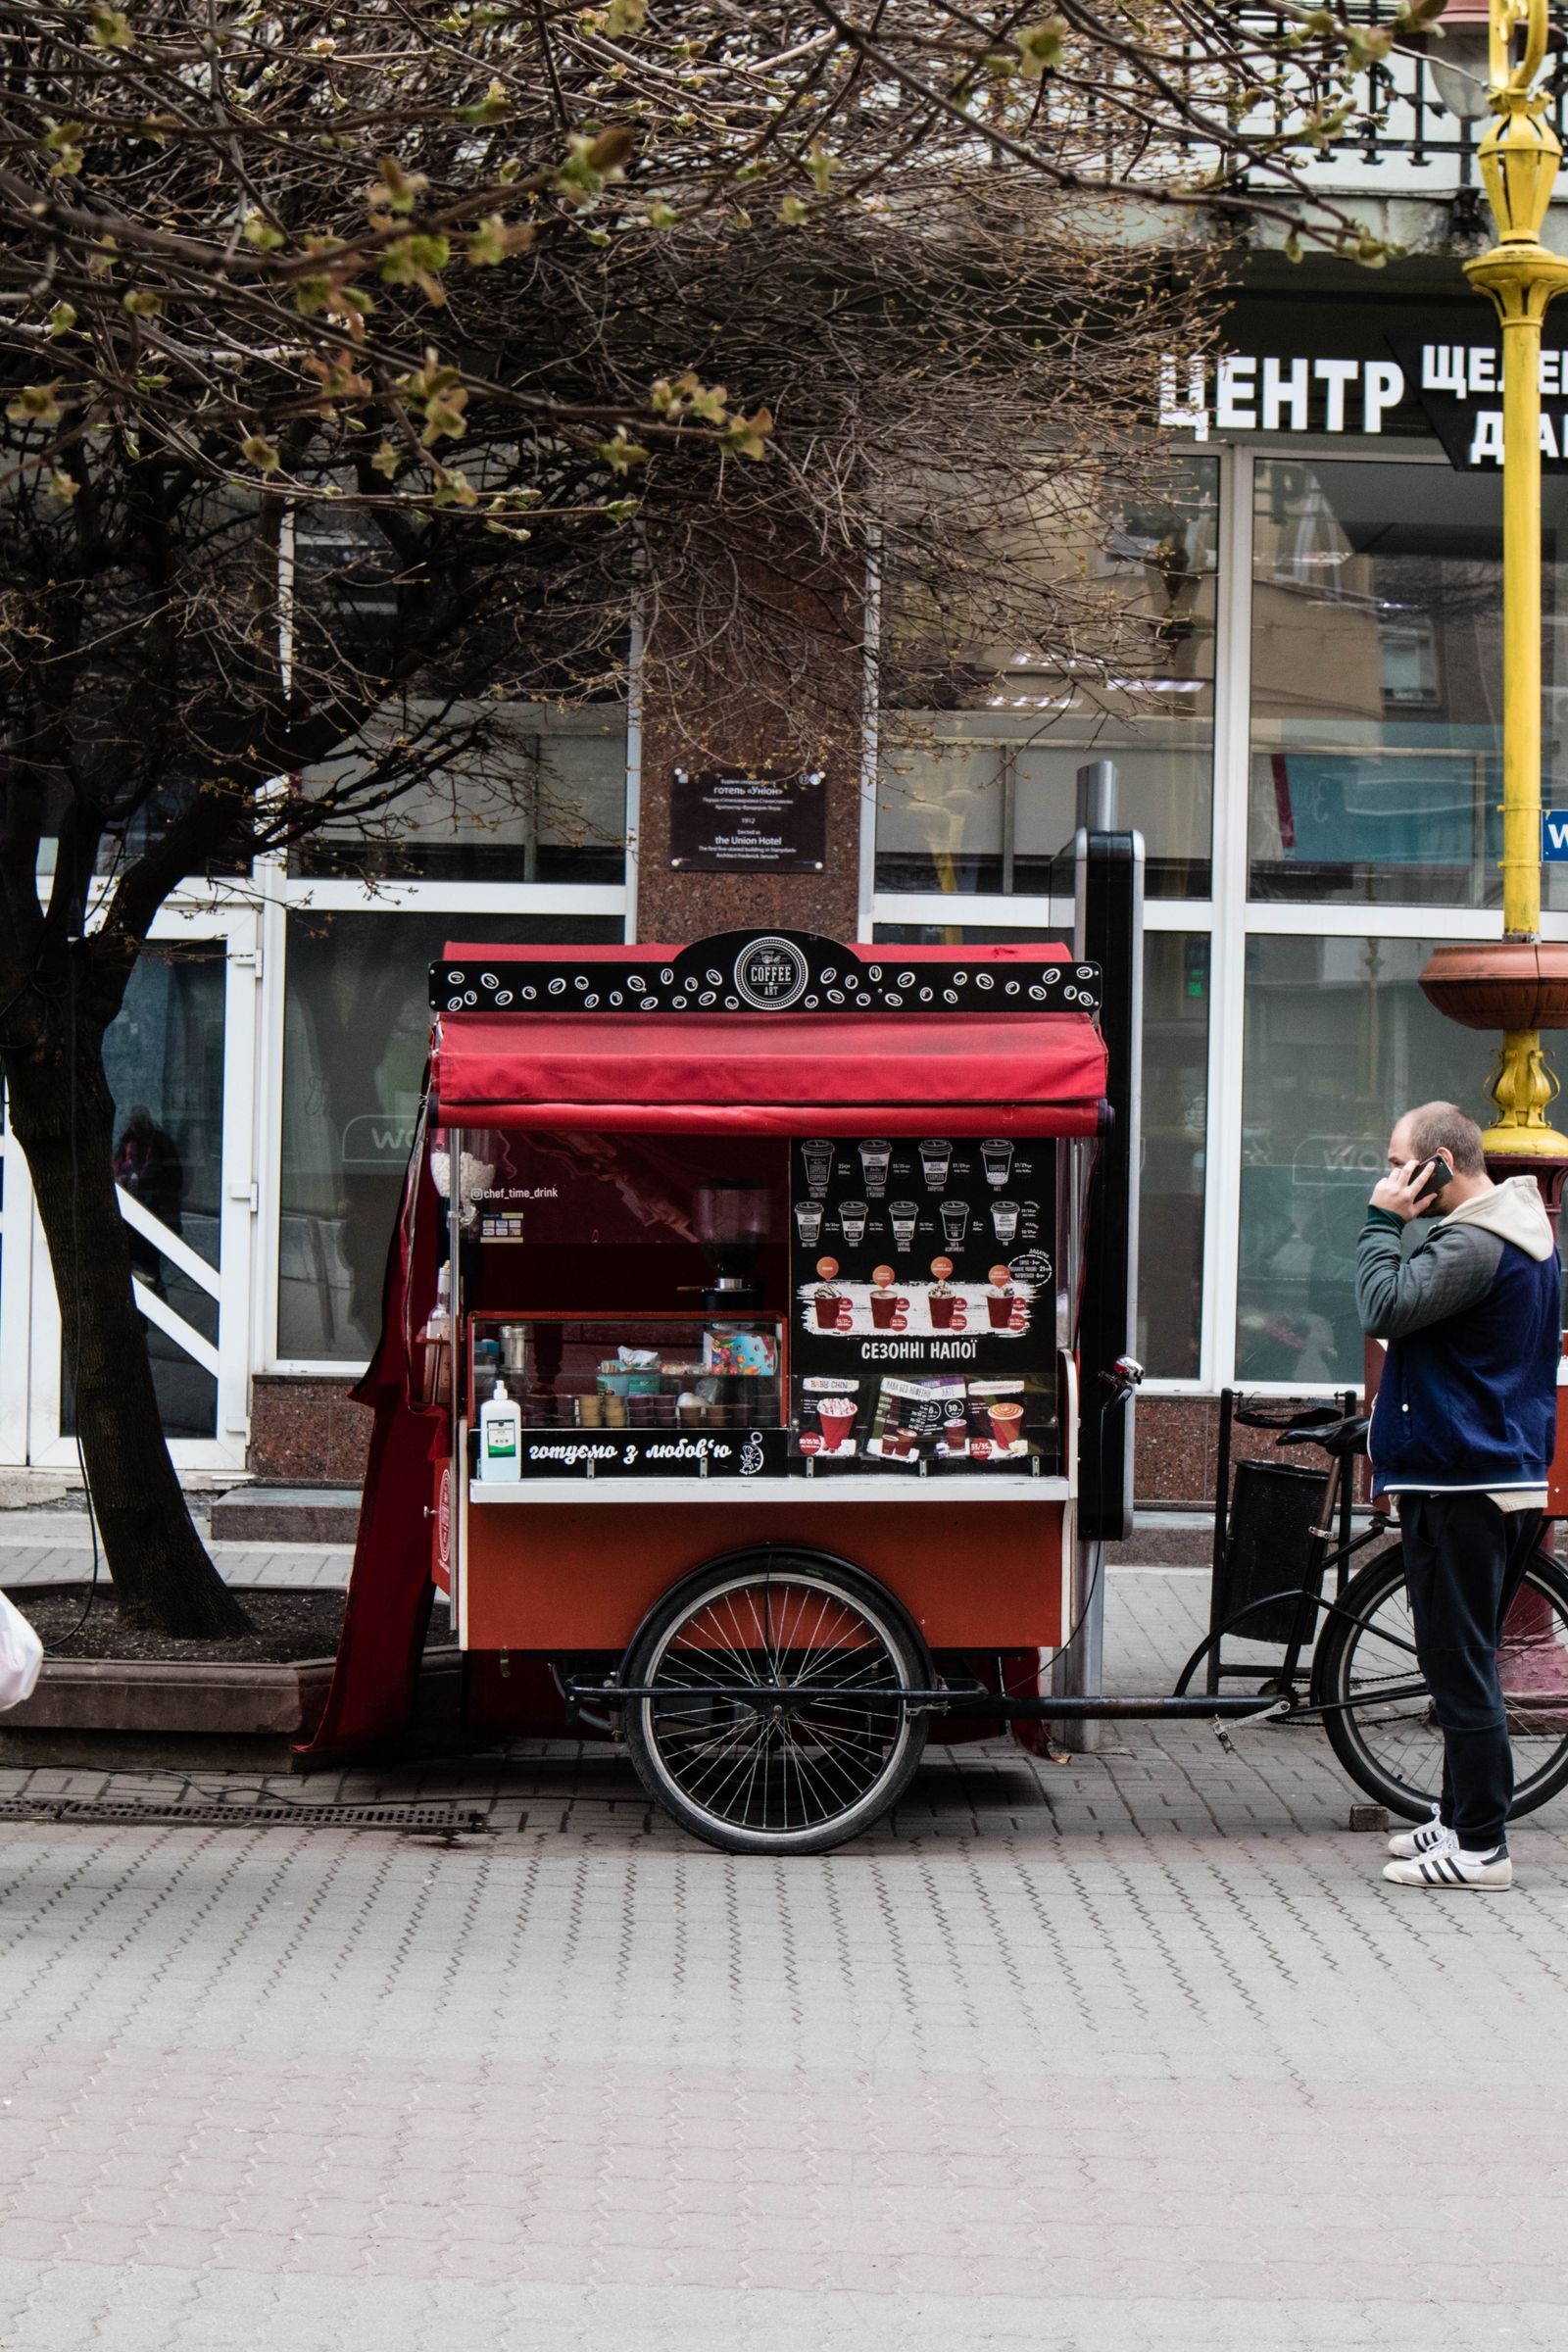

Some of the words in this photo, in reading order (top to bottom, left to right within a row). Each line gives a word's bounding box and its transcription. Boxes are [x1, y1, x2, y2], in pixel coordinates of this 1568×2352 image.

[1159, 355, 1405, 441] ЦЕНТР
[714, 836, 729, 845] the
[731, 836, 757, 845] Union
[751, 966, 791, 982] COFFEE
[764, 986, 778, 996] ART
[484, 1188, 558, 1200] chef_time_drink
[861, 1341, 924, 1359] СЕЗОННІ
[930, 1340, 977, 1359] НАПОЇ
[529, 1444, 618, 1465] готуємо
[622, 1444, 639, 1465] з
